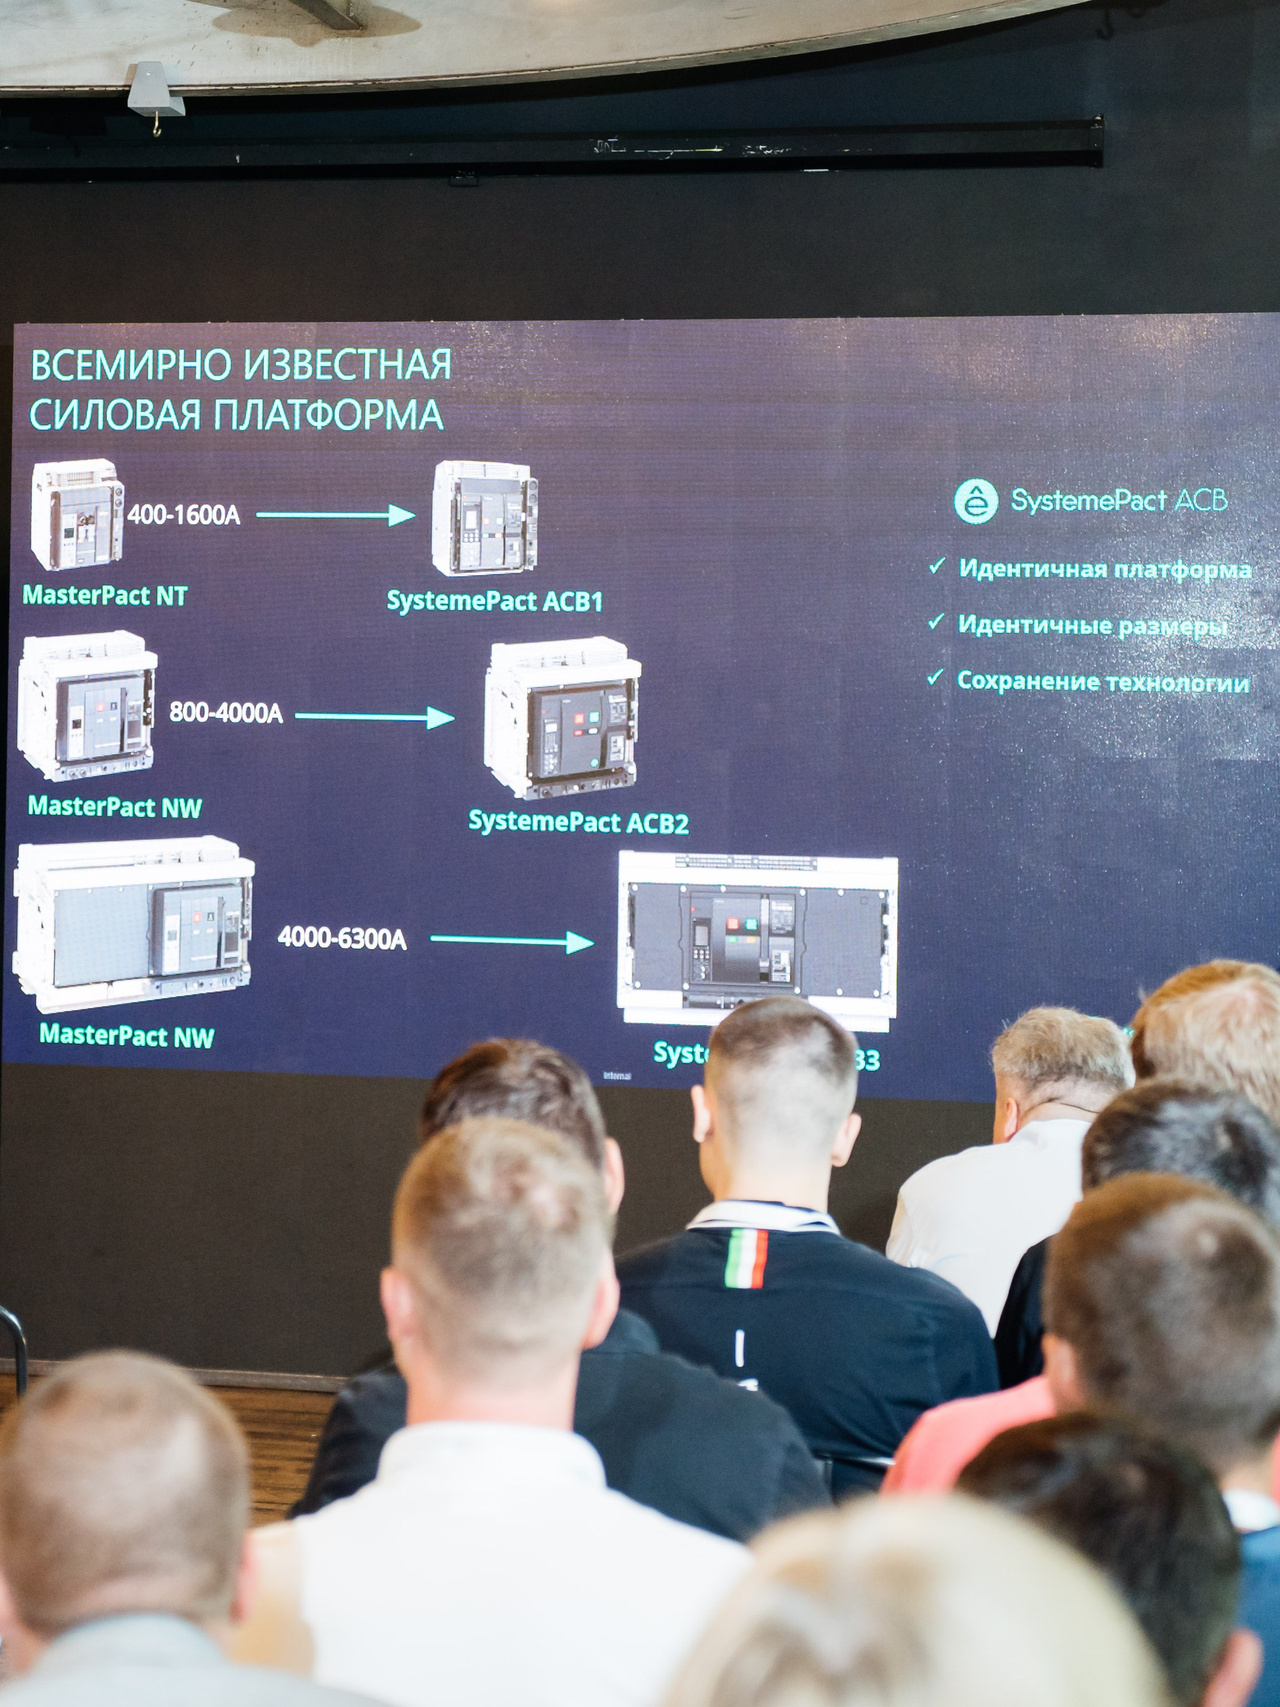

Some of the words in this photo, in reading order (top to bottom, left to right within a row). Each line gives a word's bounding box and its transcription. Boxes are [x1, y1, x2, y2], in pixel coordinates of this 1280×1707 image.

[32, 348, 232, 382] ВСЕМИРНО
[244, 347, 451, 381] ИЗВЕСТНАЯ
[29, 397, 201, 431] СИЛОВАЯ
[214, 397, 445, 431] ПЛАТФОРМА
[1011, 487, 1168, 515] SystemePact
[1173, 487, 1229, 512] ACB
[959, 558, 1108, 581] Идентичная
[1114, 560, 1253, 585] платформа
[22, 584, 151, 606] MasterPact
[156, 586, 189, 607] NT
[387, 589, 537, 617] SystemePact
[542, 591, 603, 613] ACB1
[958, 613, 1114, 638] Идентичные
[1118, 617, 1228, 641] размеры
[957, 669, 1102, 695] Сохранение
[1106, 675, 1251, 694] технологии
[28, 794, 156, 818] MasterPact
[161, 797, 203, 819] NW
[468, 809, 622, 837] SystemePact
[626, 812, 690, 835] ACB2
[39, 1022, 169, 1047] MasterPact
[174, 1026, 216, 1049] NW
[855, 1048, 881, 1071] B3
